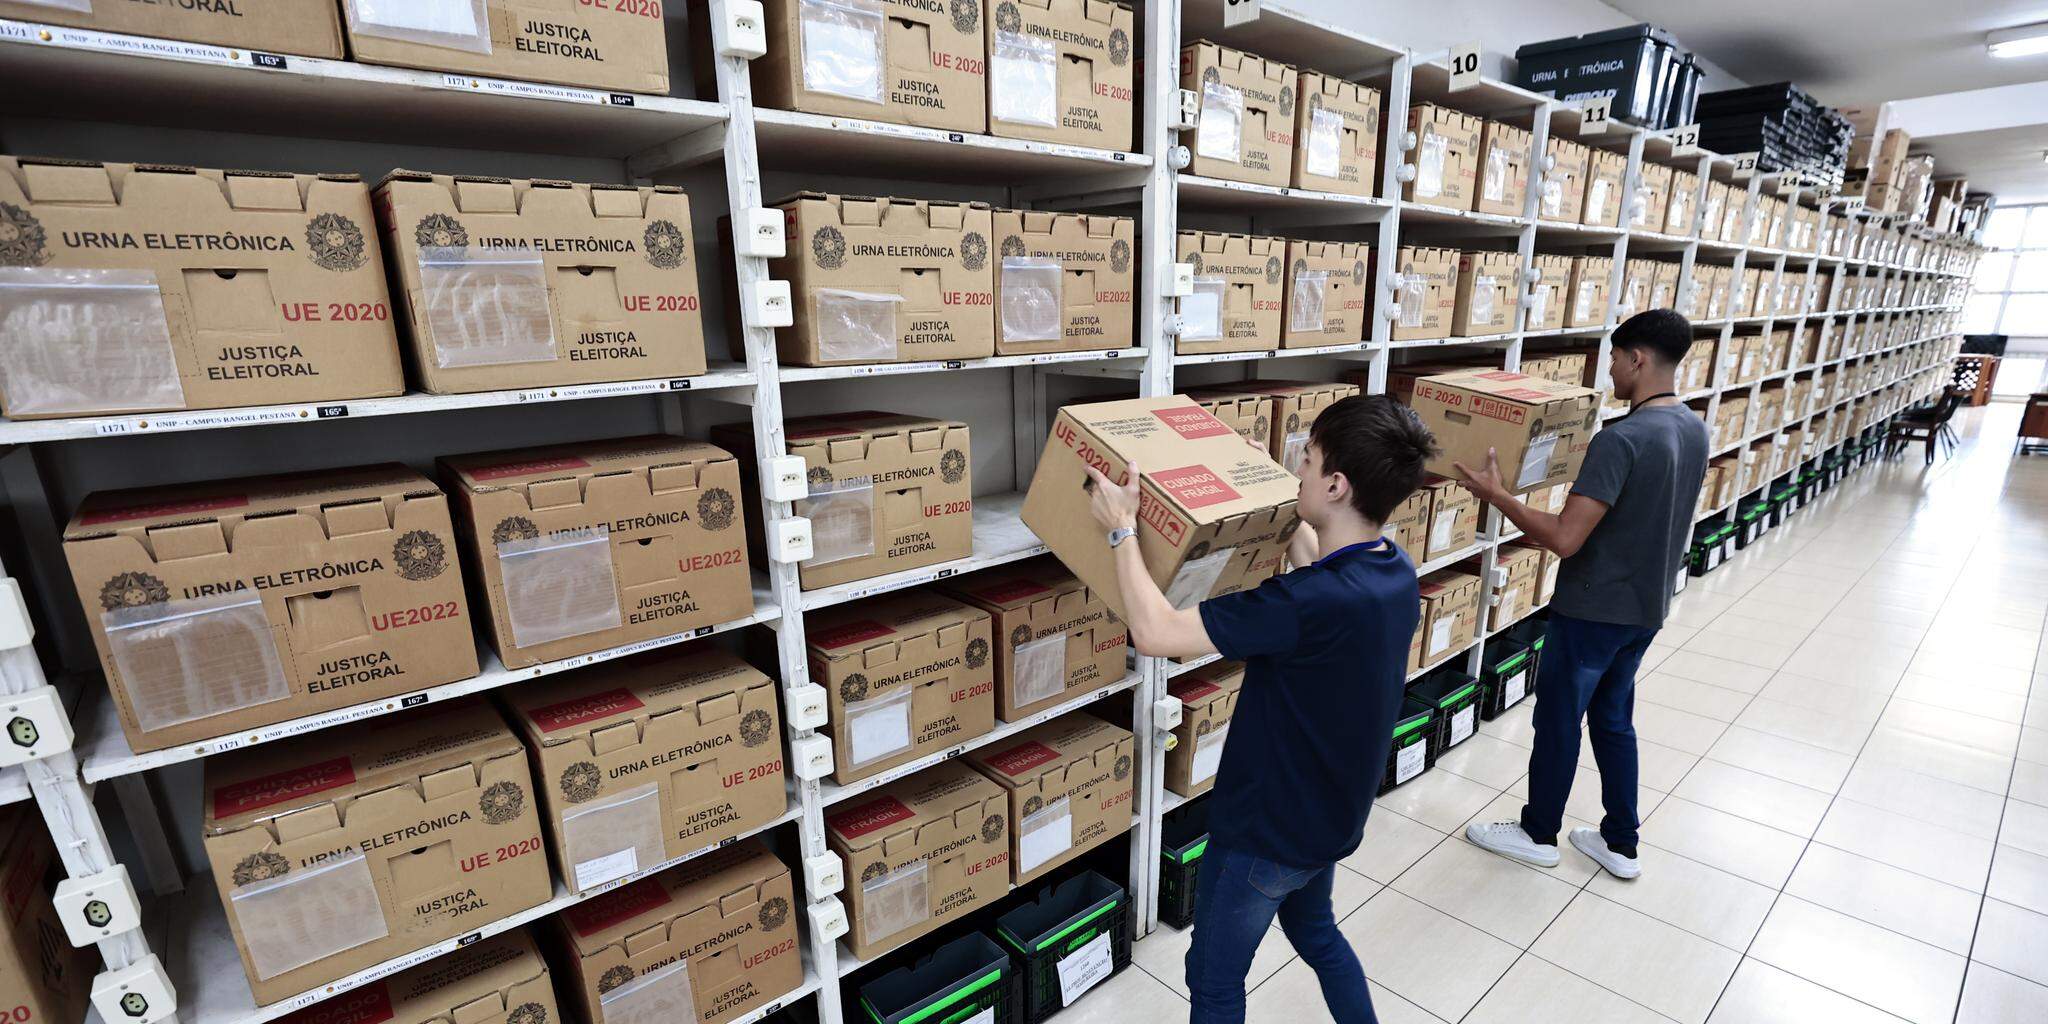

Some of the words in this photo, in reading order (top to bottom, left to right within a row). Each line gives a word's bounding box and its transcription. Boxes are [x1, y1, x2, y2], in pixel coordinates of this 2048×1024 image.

[615, 0, 660, 19] 2020
[524, 20, 592, 43] JUSTIÇA
[1026, 23, 1051, 38] URNA
[1052, 28, 1104, 50] ELETRÔNICA
[62, 33, 89, 43] UNIP
[142, 42, 182, 54] RANGEL
[184, 47, 227, 60] PESTANA
[515, 37, 604, 62] ELEITORAL
[933, 52, 951, 68] UE
[954, 55, 984, 75] 2020
[1452, 52, 1478, 76] 10
[1532, 71, 1557, 83] URNA
[1564, 59, 1624, 81] ETRÔNICA
[447, 77, 466, 87] 1171
[487, 81, 505, 90] UNIP
[898, 79, 939, 95] JUSTIÇA
[1094, 82, 1108, 96] UE
[1110, 85, 1132, 101] 2020
[891, 92, 946, 110] ELEITORAL
[1067, 105, 1099, 119] JUSTIÇA
[1585, 105, 1606, 122] 11
[1062, 117, 1103, 132] ELEITORAL
[1266, 130, 1277, 144] UE
[1675, 132, 1696, 147] 12
[1247, 150, 1269, 163] JUSTIÇA
[1356, 148, 1365, 159] UE
[1243, 159, 1270, 171] ELEITORAL
[1736, 159, 1755, 170] 13
[1782, 177, 1798, 187] 14
[1818, 190, 1831, 199] 15
[1849, 201, 1863, 210] 16
[1870, 216, 1882, 225] 17
[62, 231, 139, 249] URNA
[145, 231, 296, 251] ELETRÔNICA
[534, 235, 636, 252] ELETRÔNICA
[852, 245, 885, 256] URNA
[887, 243, 955, 258] ELETRÔNICA
[1056, 250, 1106, 263] ELETRÔNICA
[1206, 265, 1224, 274] URNA
[1225, 265, 1263, 276] ELETRÔNICA
[623, 296, 652, 311] UE
[656, 295, 698, 311] 2020
[943, 292, 962, 306] UE
[965, 292, 992, 306] 2020
[1095, 290, 1130, 303] UE2022
[1253, 300, 1264, 310] UE
[281, 303, 321, 322] UE
[329, 303, 388, 321] 2020
[1070, 316, 1100, 328] JUSTIÇA
[910, 321, 950, 334] JUSTIÇA
[1065, 326, 1104, 337] ELEITORAL
[1228, 330, 1258, 338] ELEITORAL
[1232, 321, 1256, 330] JUSTIÇA
[1323, 326, 1346, 334] ELEITORAL
[577, 331, 637, 346] JUSTIÇA
[904, 332, 956, 344] ELEITORAL
[218, 345, 303, 363] JUSTIÇA
[569, 346, 648, 362] ELEITORAL
[207, 362, 319, 381] ELEITORAL
[529, 391, 544, 400] 1171
[1416, 386, 1431, 398] UE
[1436, 390, 1462, 406] 2020
[102, 423, 126, 433] 1171
[155, 419, 177, 429] UNIP
[185, 416, 220, 426] CAMPUS
[223, 414, 257, 423] RANGEL
[259, 411, 297, 420] PESTANA
[1055, 420, 1073, 449] UE
[1077, 441, 1111, 476] 2020
[872, 466, 936, 484] ELETRÔNICA
[1163, 472, 1216, 488] CUIDADO
[1182, 485, 1225, 500] FRÁGIL
[924, 505, 941, 518] UE
[945, 500, 971, 516] 2020
[597, 510, 690, 536] ELETRÔNICA
[893, 531, 931, 546] JUSTIÇA
[888, 542, 937, 559] ELEITORAL
[678, 549, 743, 573] UE2022
[183, 578, 249, 600] URNA
[253, 557, 385, 591] ELETRÔNICA
[636, 589, 690, 610] JUSTIÇA
[371, 600, 460, 632] UE2022
[629, 601, 700, 625] ELEITORAL
[1037, 625, 1057, 639] URNA
[1058, 612, 1103, 632] ELETRÔNICA
[1095, 634, 1126, 654] UE2022
[316, 650, 392, 676] JUSTIÇA
[567, 658, 582, 668] 1171
[1071, 663, 1097, 679] JUSTIÇA
[307, 663, 405, 694] ELEITORAL
[874, 674, 901, 690] URNA
[902, 657, 961, 681] ELETRÔNICA
[1067, 671, 1101, 689] ELEITORAL
[951, 688, 967, 704] UE
[969, 681, 993, 698] 2020
[219, 740, 240, 752] 1171
[264, 728, 284, 739] UNIP
[290, 720, 320, 734] CAMPUS
[321, 713, 350, 726] RANGEL
[352, 705, 385, 719] PESTANA
[922, 715, 957, 733] JUSTIÇA
[917, 723, 961, 745] ELEITORAL
[609, 760, 649, 780] URNA
[651, 733, 733, 768] ELETRÔNICA
[1007, 751, 1047, 771] FRÁGIL
[722, 772, 744, 788] UE
[748, 759, 782, 781] 2020
[1068, 772, 1110, 797] ELETRÔNICA
[1101, 798, 1113, 811] UE
[1114, 789, 1133, 806] 2020
[685, 802, 733, 825] JUSTIÇA
[851, 809, 898, 830] FRÁGIL
[679, 811, 741, 840] ELEITORAL
[1079, 820, 1104, 837] JUSTIÇA
[301, 845, 353, 869] URNA
[361, 809, 471, 852] ELETRÔNICA
[1074, 825, 1108, 847] ELEITORAL
[460, 854, 491, 873] UE
[496, 836, 541, 864] 2020
[922, 833, 977, 860] ELETRÔNICA
[967, 861, 983, 876] UE
[985, 851, 1009, 870] 2020
[934, 893, 977, 917] ELEITORAL
[939, 886, 973, 906] JUSTIÇA
[642, 956, 677, 976] URNA
[679, 922, 753, 958] ELETRÔNICA
[743, 938, 795, 970] UE2022
[297, 996, 315, 1006] 1171
[337, 981, 355, 991] UNIP
[358, 968, 386, 984] CAMPUS
[387, 959, 413, 974] RANGEL
[414, 949, 442, 964] PESTANA
[711, 981, 753, 1007] JUSTIÇA
[704, 989, 760, 1020] ELEITORAL
